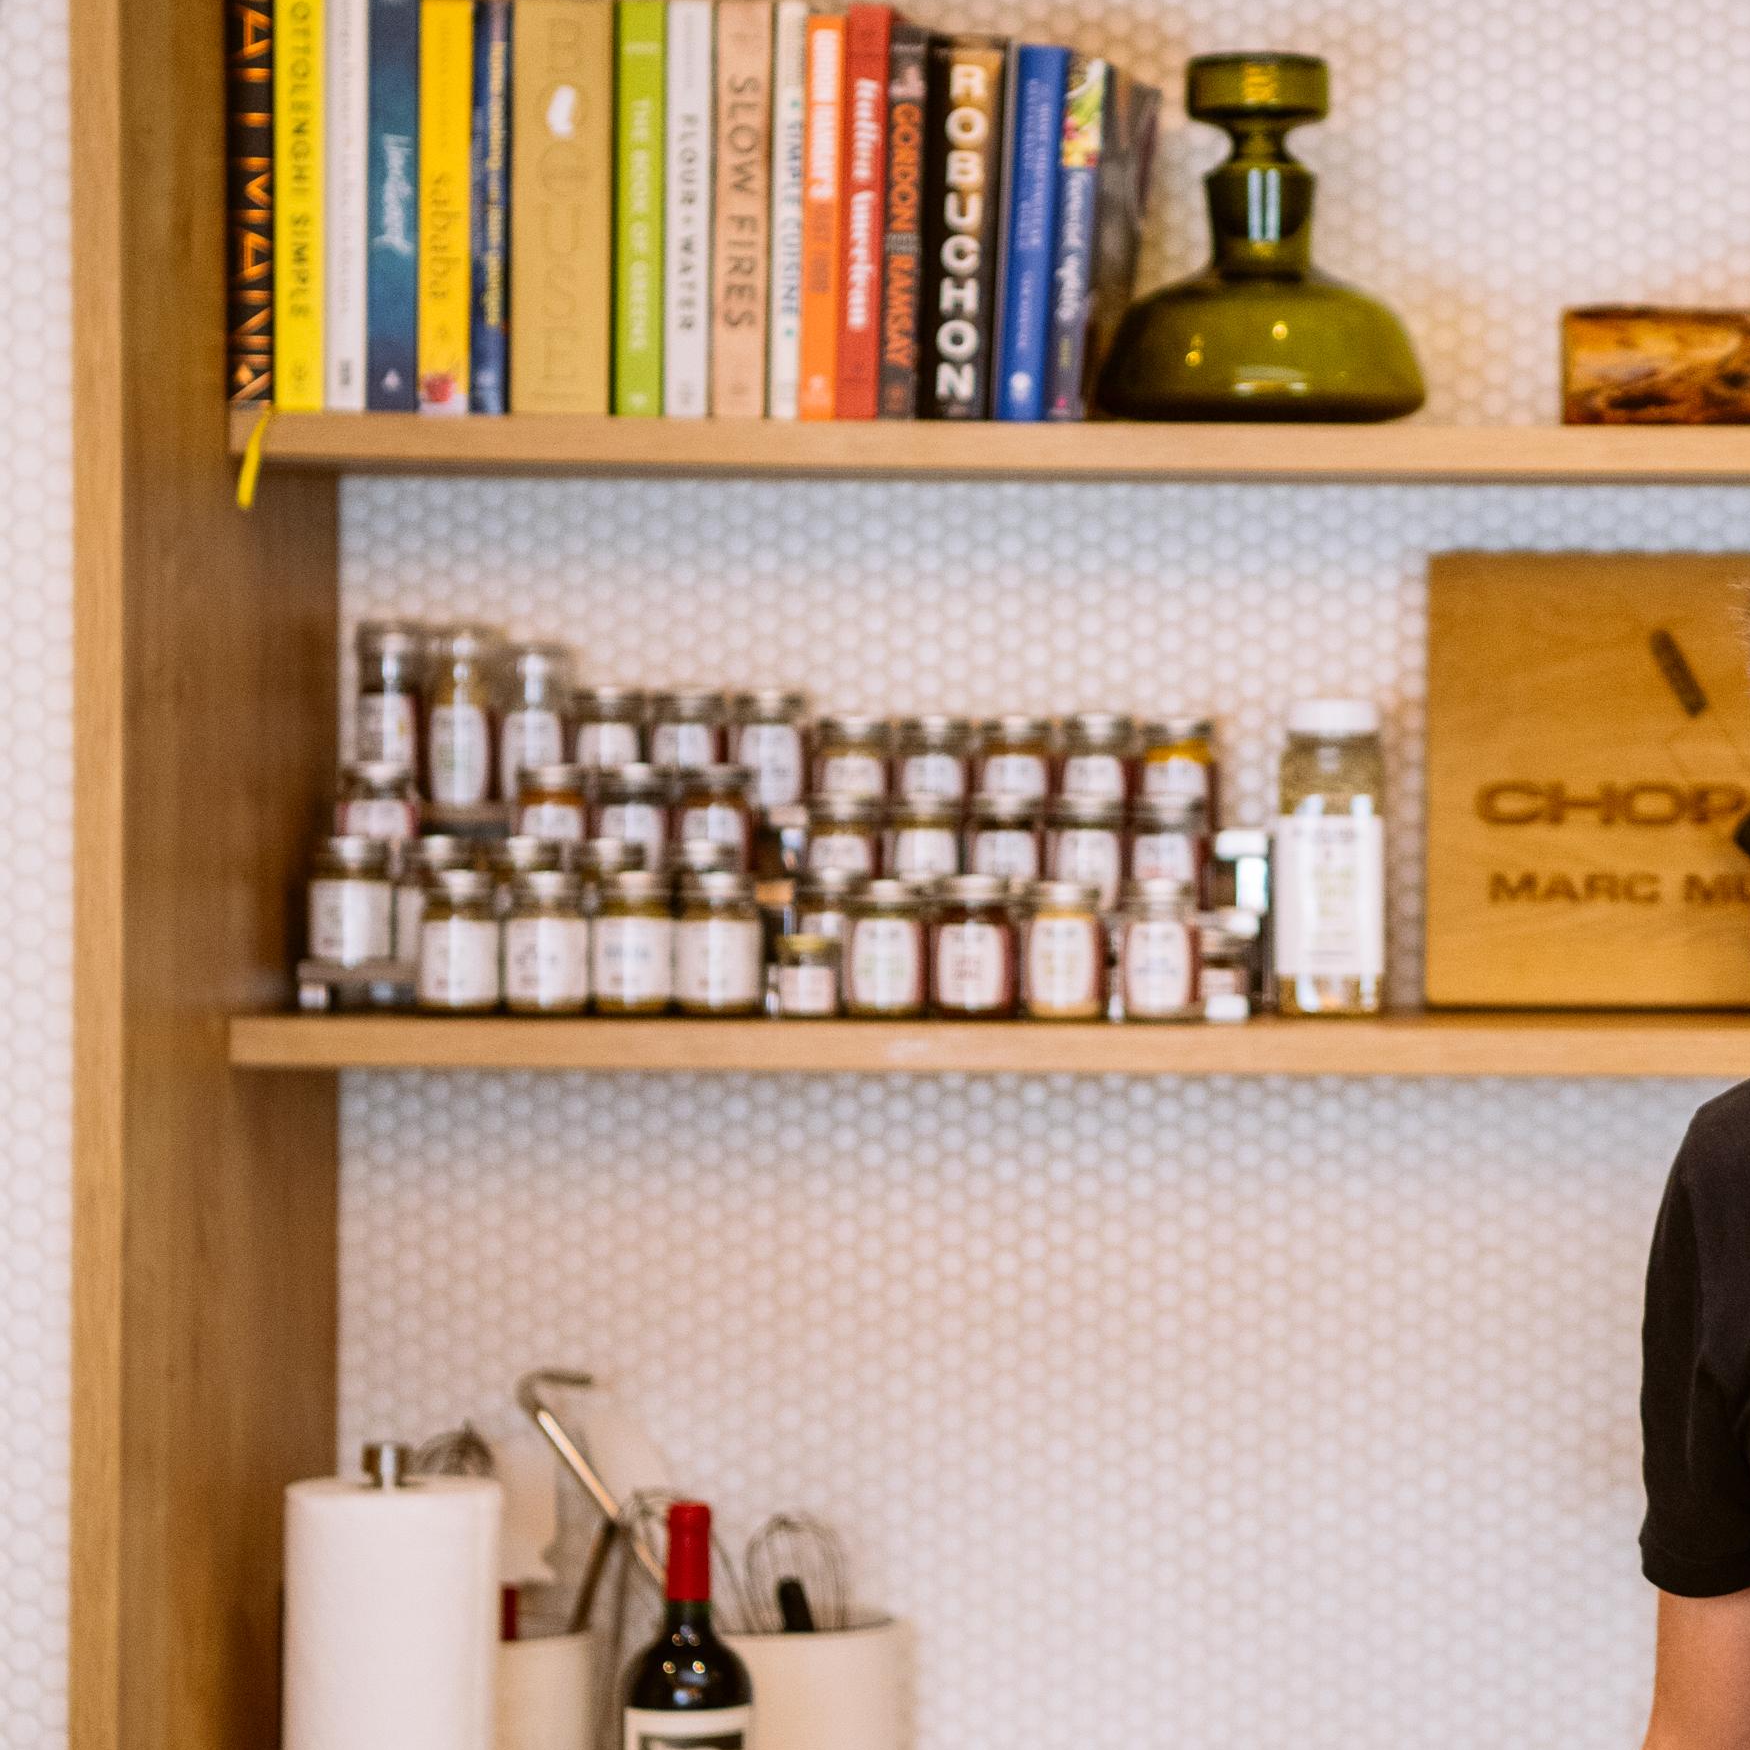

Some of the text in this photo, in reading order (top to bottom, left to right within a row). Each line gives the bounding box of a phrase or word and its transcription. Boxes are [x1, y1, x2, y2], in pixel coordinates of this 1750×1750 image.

[289, 0, 313, 321] OTTOLENGHI SIMPLE
[678, 113, 698, 207] FLOUR
[723, 74, 760, 331] SLOW FIRES
[780, 118, 803, 317] SIMPLE CUISINE
[889, 101, 922, 232] GORDON
[427, 171, 462, 300] sababa
[628, 98, 651, 354] THE BOOK OF GREENS
[677, 232, 698, 333] WATER
[935, 62, 990, 402] ROBUCHON
[884, 253, 917, 368] RAMSAY
[1489, 871, 1660, 905] MARC
